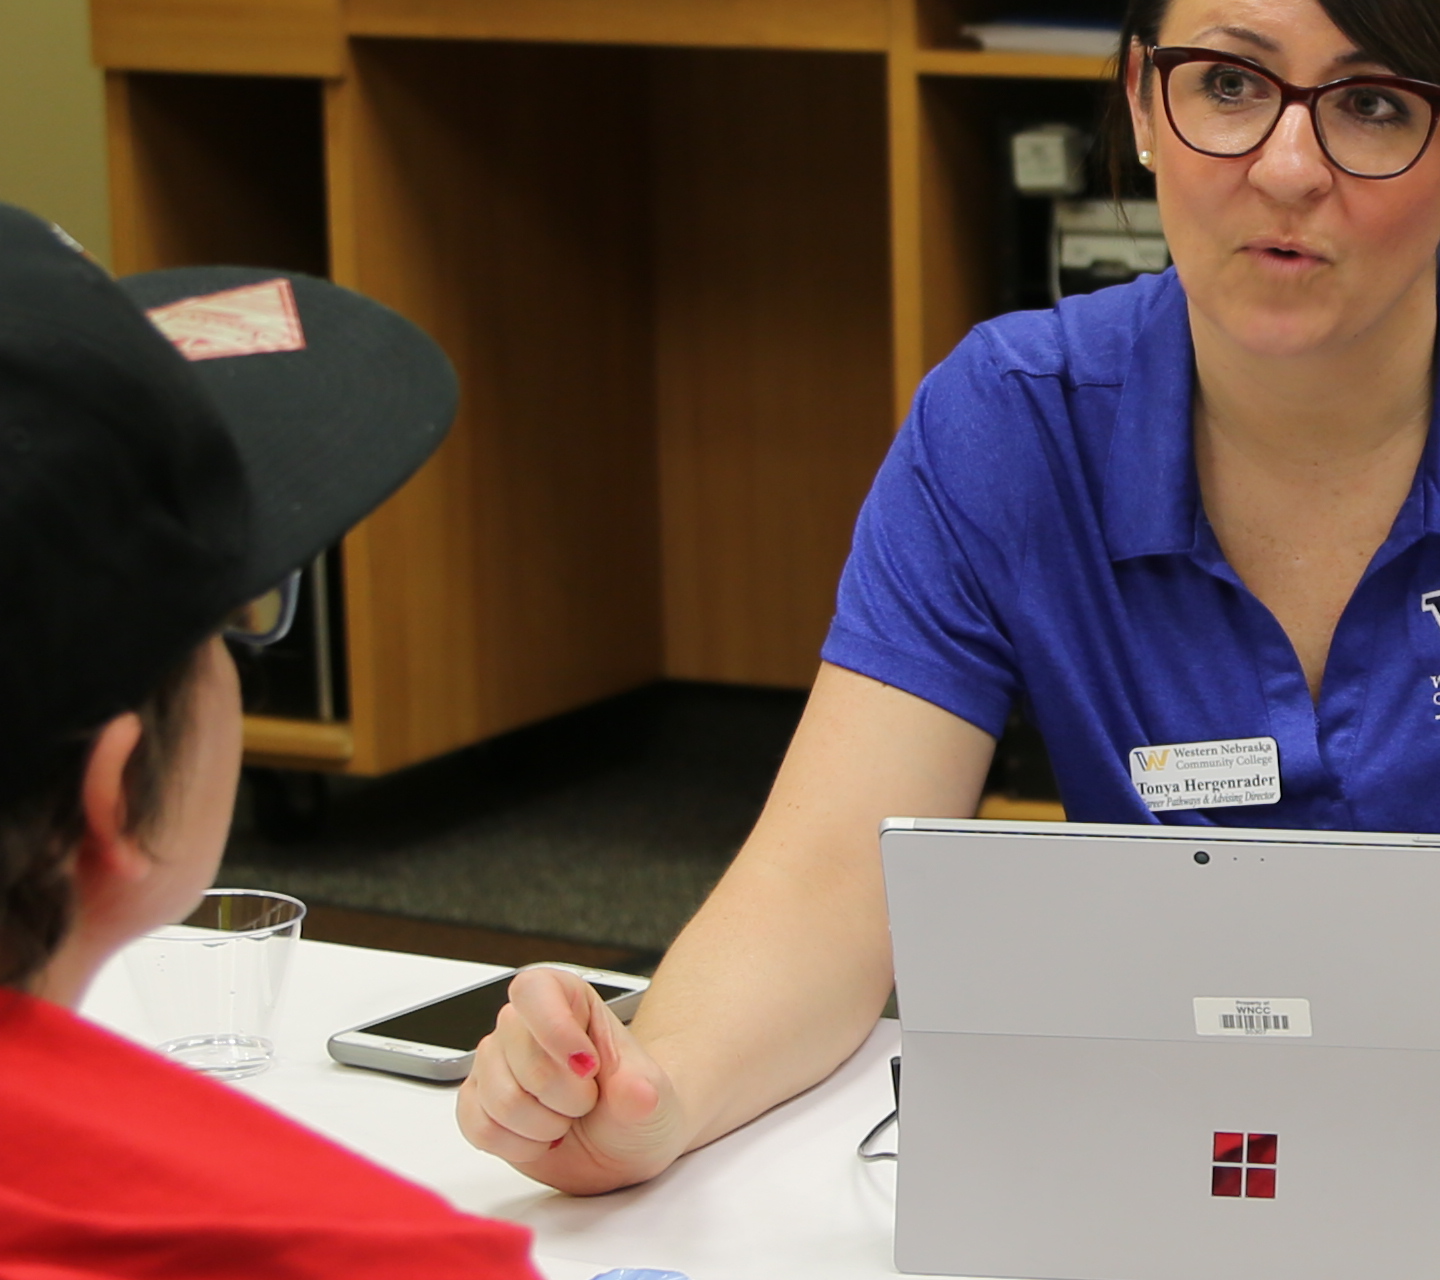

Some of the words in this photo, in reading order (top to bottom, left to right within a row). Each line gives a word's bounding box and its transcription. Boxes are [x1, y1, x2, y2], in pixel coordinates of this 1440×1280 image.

[1174, 747, 1218, 758] Western
[1221, 742, 1272, 754] Nebraska
[1176, 758, 1234, 771] Community
[1236, 755, 1273, 767] College
[1137, 782, 1180, 798] Tonya
[1185, 774, 1276, 793] Hergenrader
[1167, 795, 1201, 807] Pathways
[1203, 795, 1210, 805] &
[1212, 792, 1243, 805] Advising
[1245, 791, 1276, 801] Director
